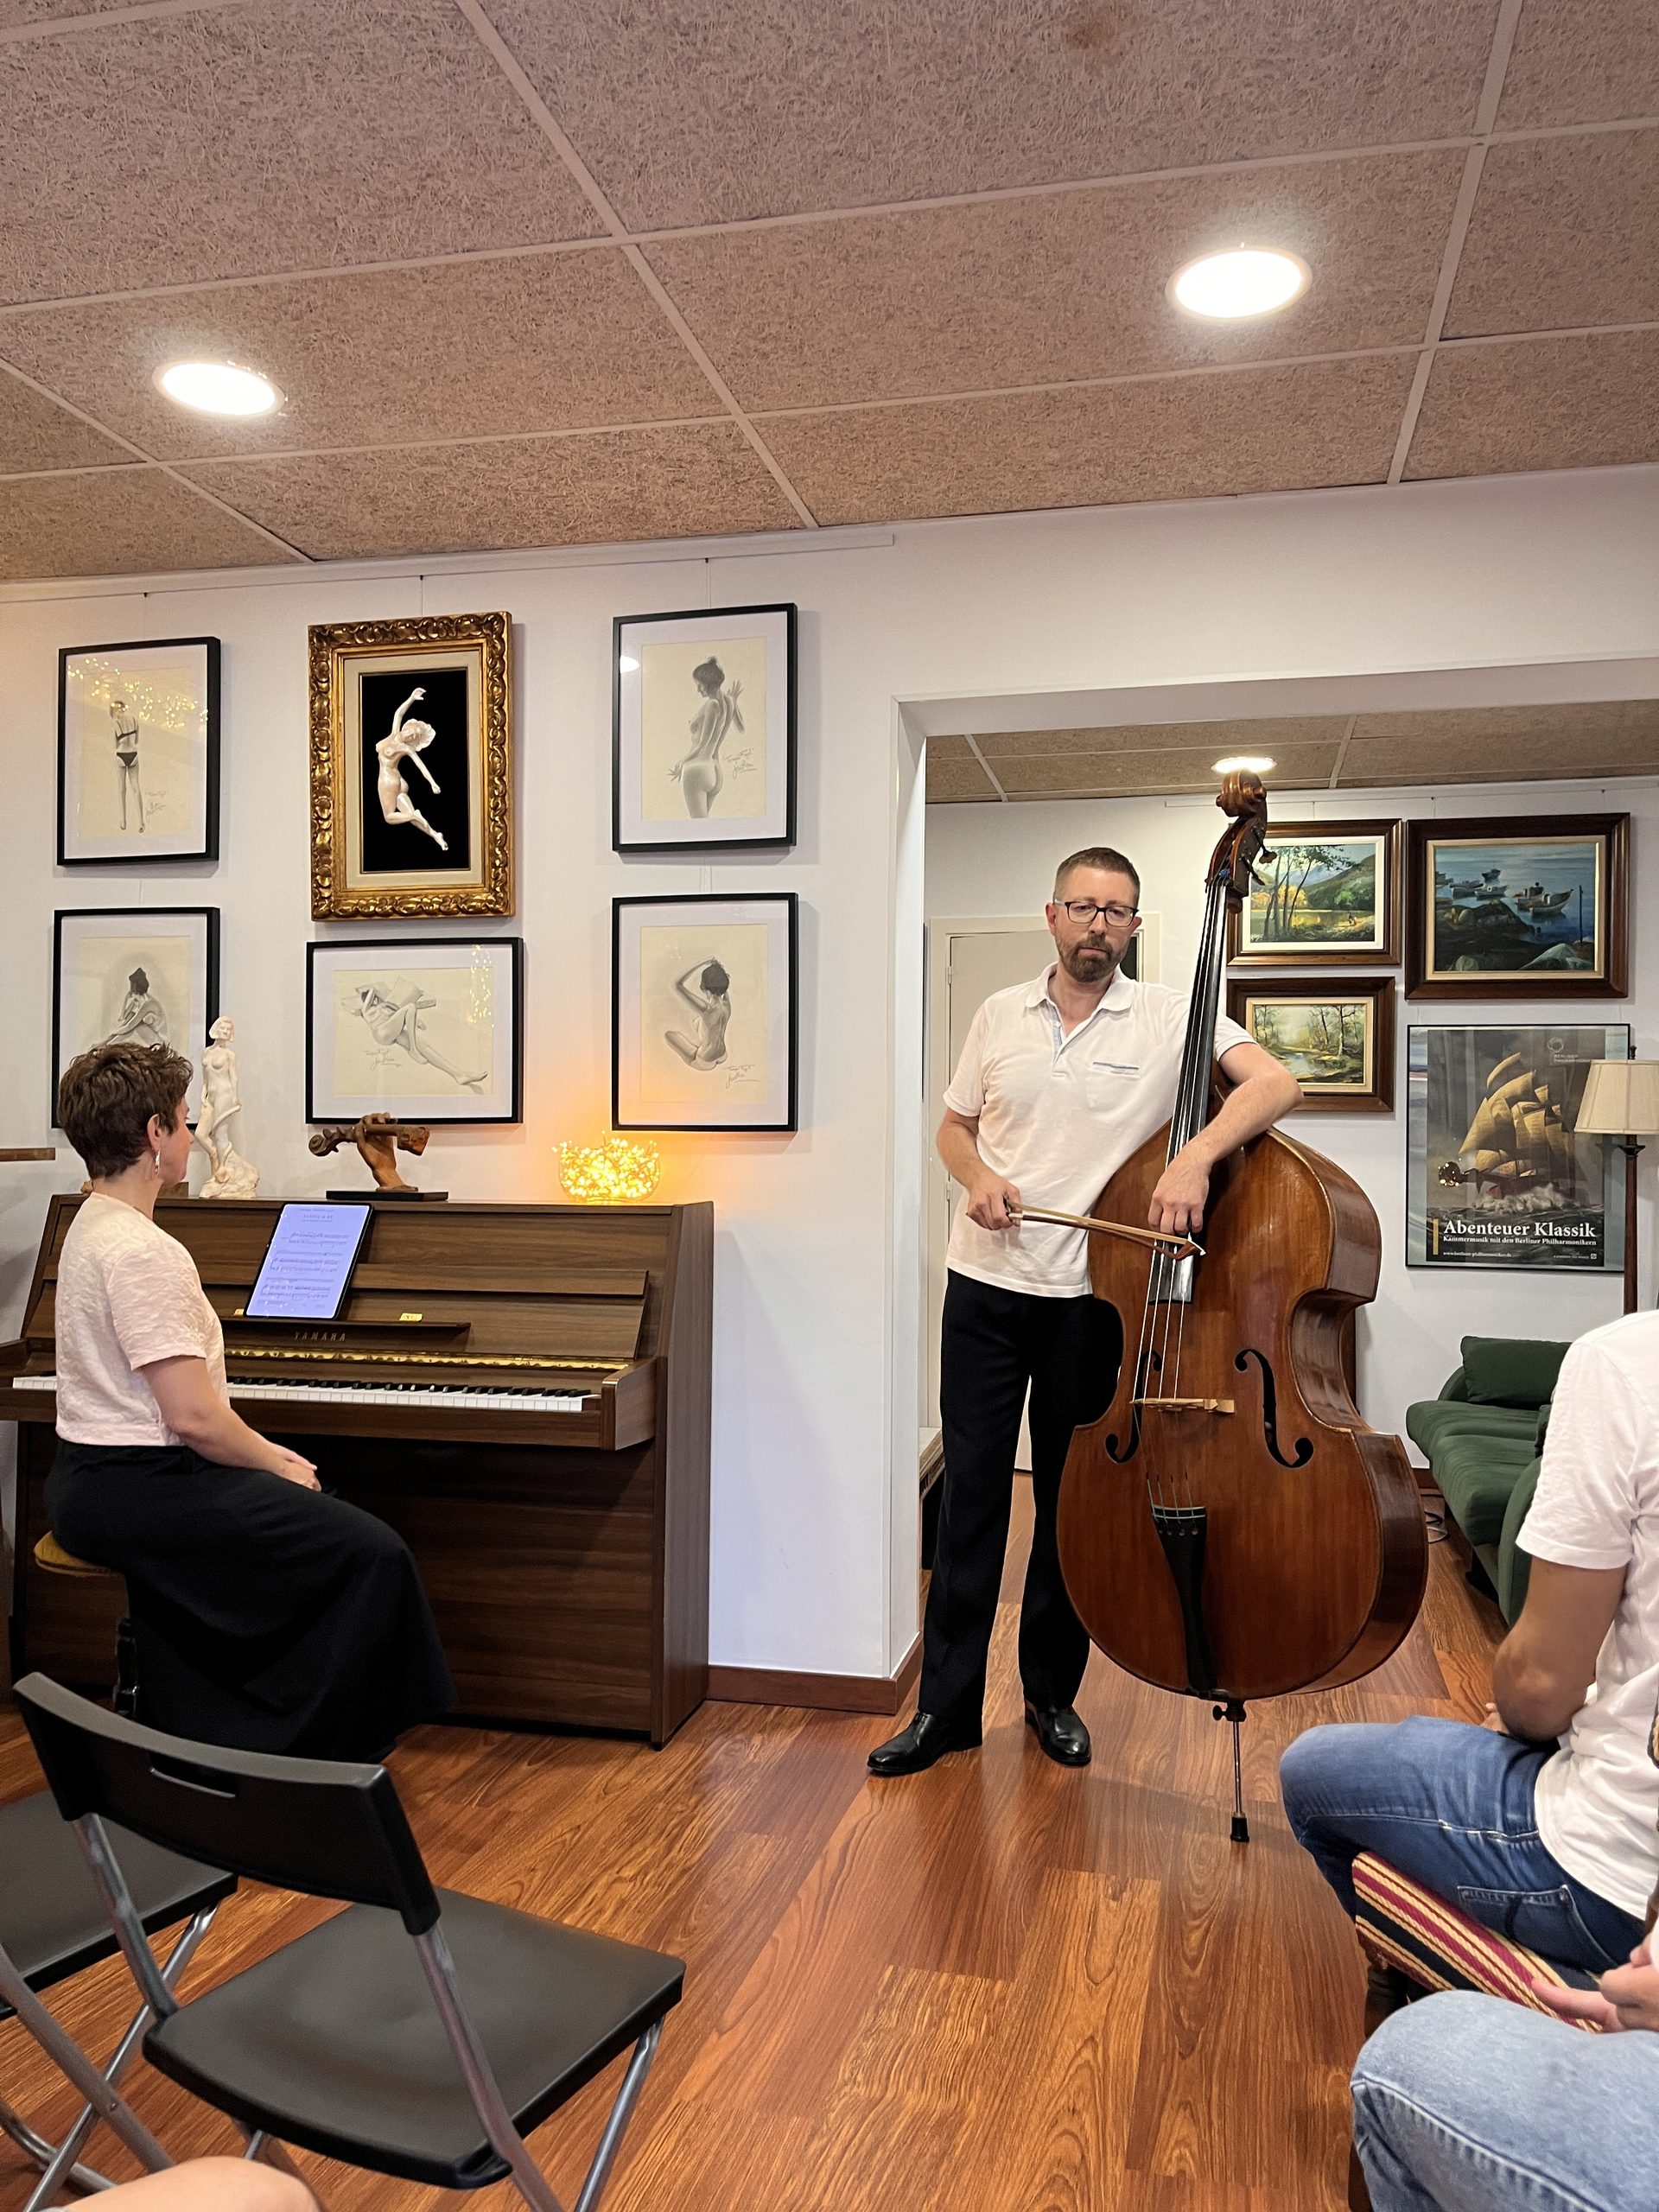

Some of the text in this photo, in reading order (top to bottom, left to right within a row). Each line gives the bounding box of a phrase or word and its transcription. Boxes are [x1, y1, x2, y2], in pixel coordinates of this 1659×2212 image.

[1443, 1220, 1597, 1237] Abenteuer Klassik
[295, 1332, 346, 1341] YAMAHA
